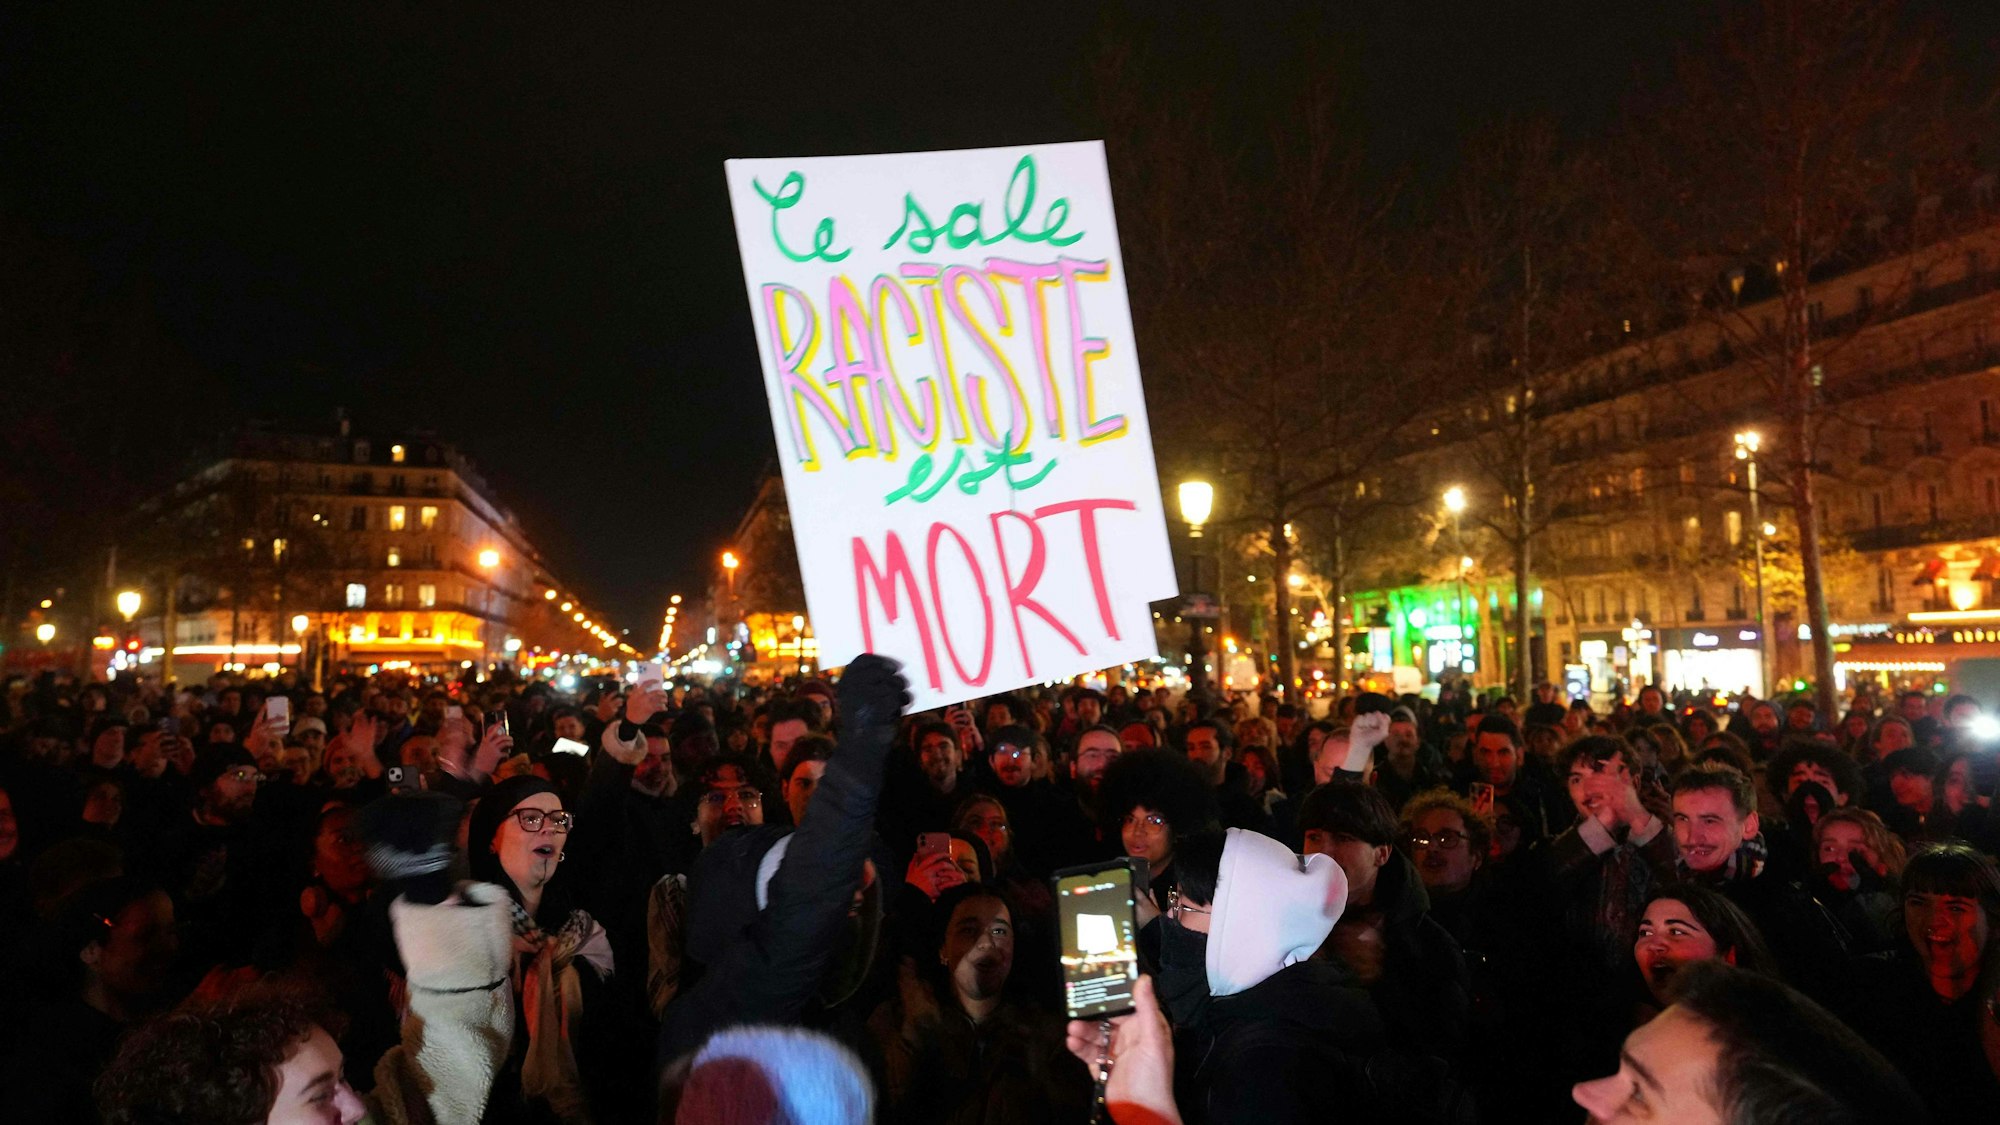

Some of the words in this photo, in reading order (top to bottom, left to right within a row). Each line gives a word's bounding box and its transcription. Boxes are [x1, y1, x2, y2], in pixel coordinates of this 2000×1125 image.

[883, 153, 1086, 254] sale
[762, 256, 1128, 472] RACISTE
[884, 428, 1058, 506] est
[852, 498, 1137, 693] MORT
